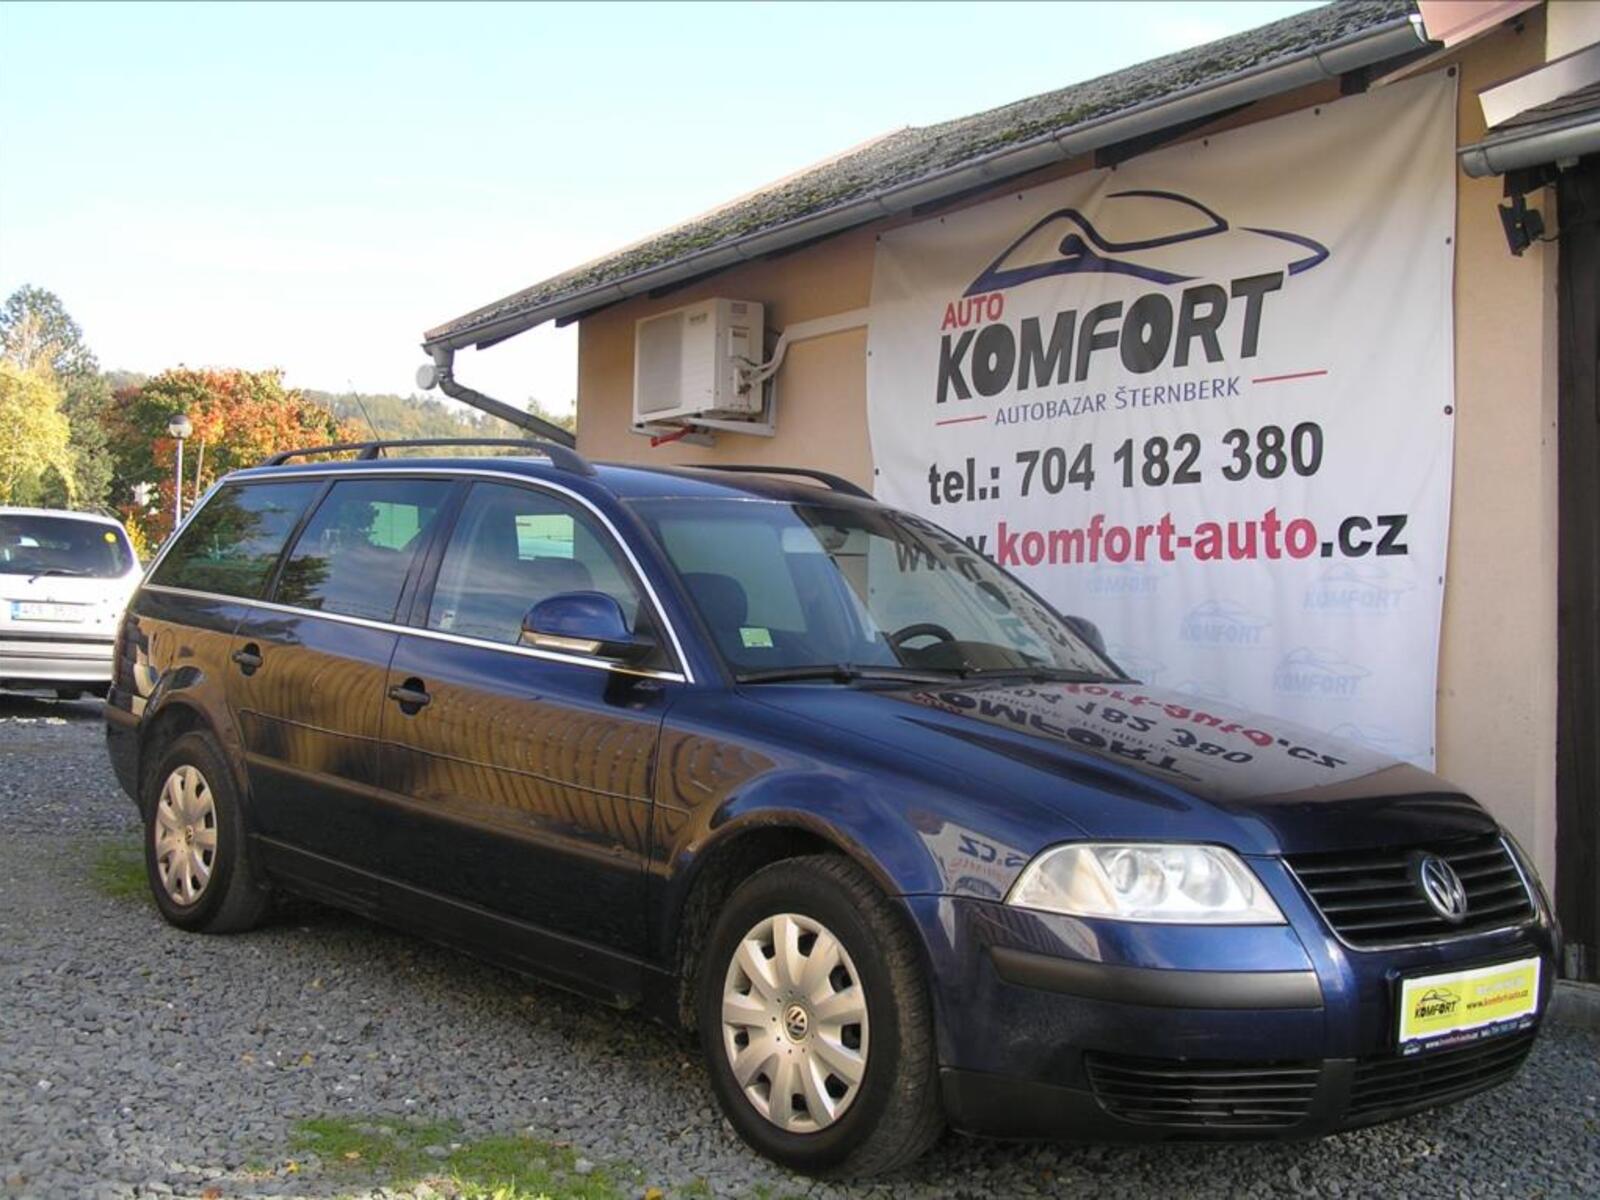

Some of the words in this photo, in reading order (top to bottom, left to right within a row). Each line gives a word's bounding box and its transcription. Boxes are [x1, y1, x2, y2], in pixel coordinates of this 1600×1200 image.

[941, 292, 1005, 331] AUTO
[936, 271, 1284, 404] KOMFORT
[994, 393, 1107, 426] AUTOBAZAR
[1114, 376, 1241, 410] ŠTERNBERK
[928, 457, 1001, 505] tel.:
[1015, 443, 1095, 497] 704
[1113, 433, 1202, 488] 182
[1221, 421, 1325, 482] 380
[1303, 587, 1404, 610] KOMFORT
[1273, 673, 1362, 696] KOMFORT
[1414, 1000, 1458, 1020] KOMFORT
